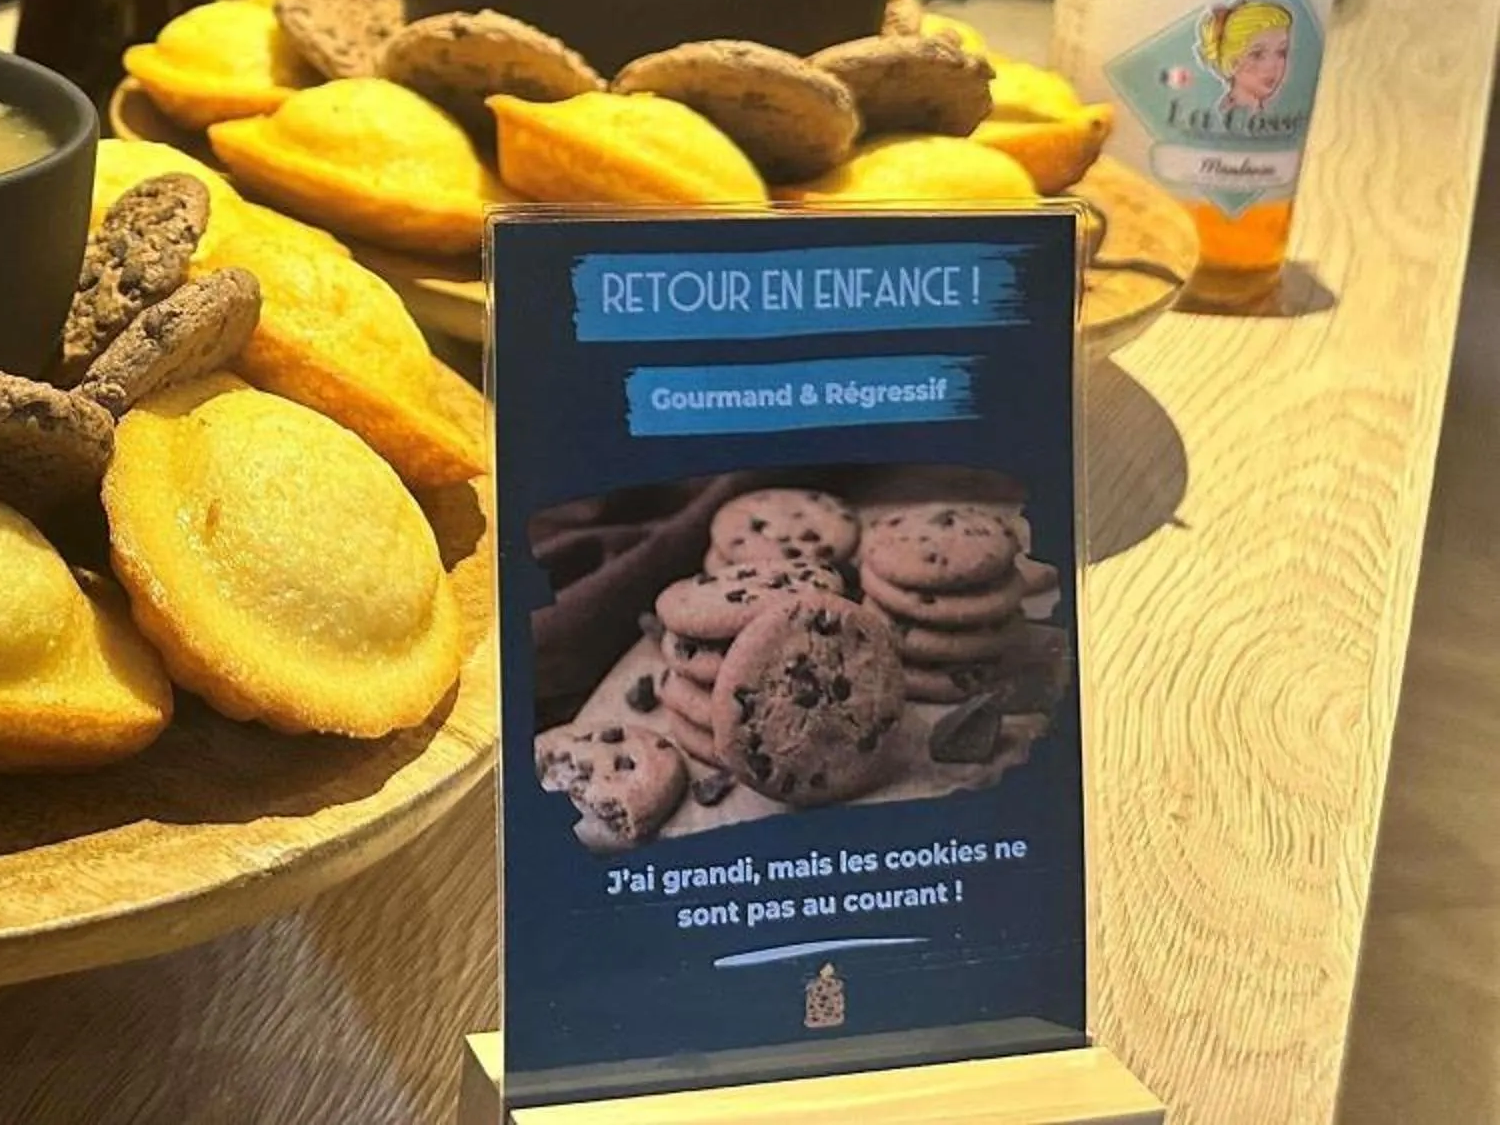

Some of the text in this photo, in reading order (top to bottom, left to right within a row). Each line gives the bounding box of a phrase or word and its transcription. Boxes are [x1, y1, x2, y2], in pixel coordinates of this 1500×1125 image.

[602, 266, 980, 314] RETOUR EN ENFANCE !
[651, 377, 947, 411] Gourmand & Régressif
[606, 838, 1028, 896] J'ai grandi, mais les cookies ne
[677, 881, 963, 930] sont pas au courant !
